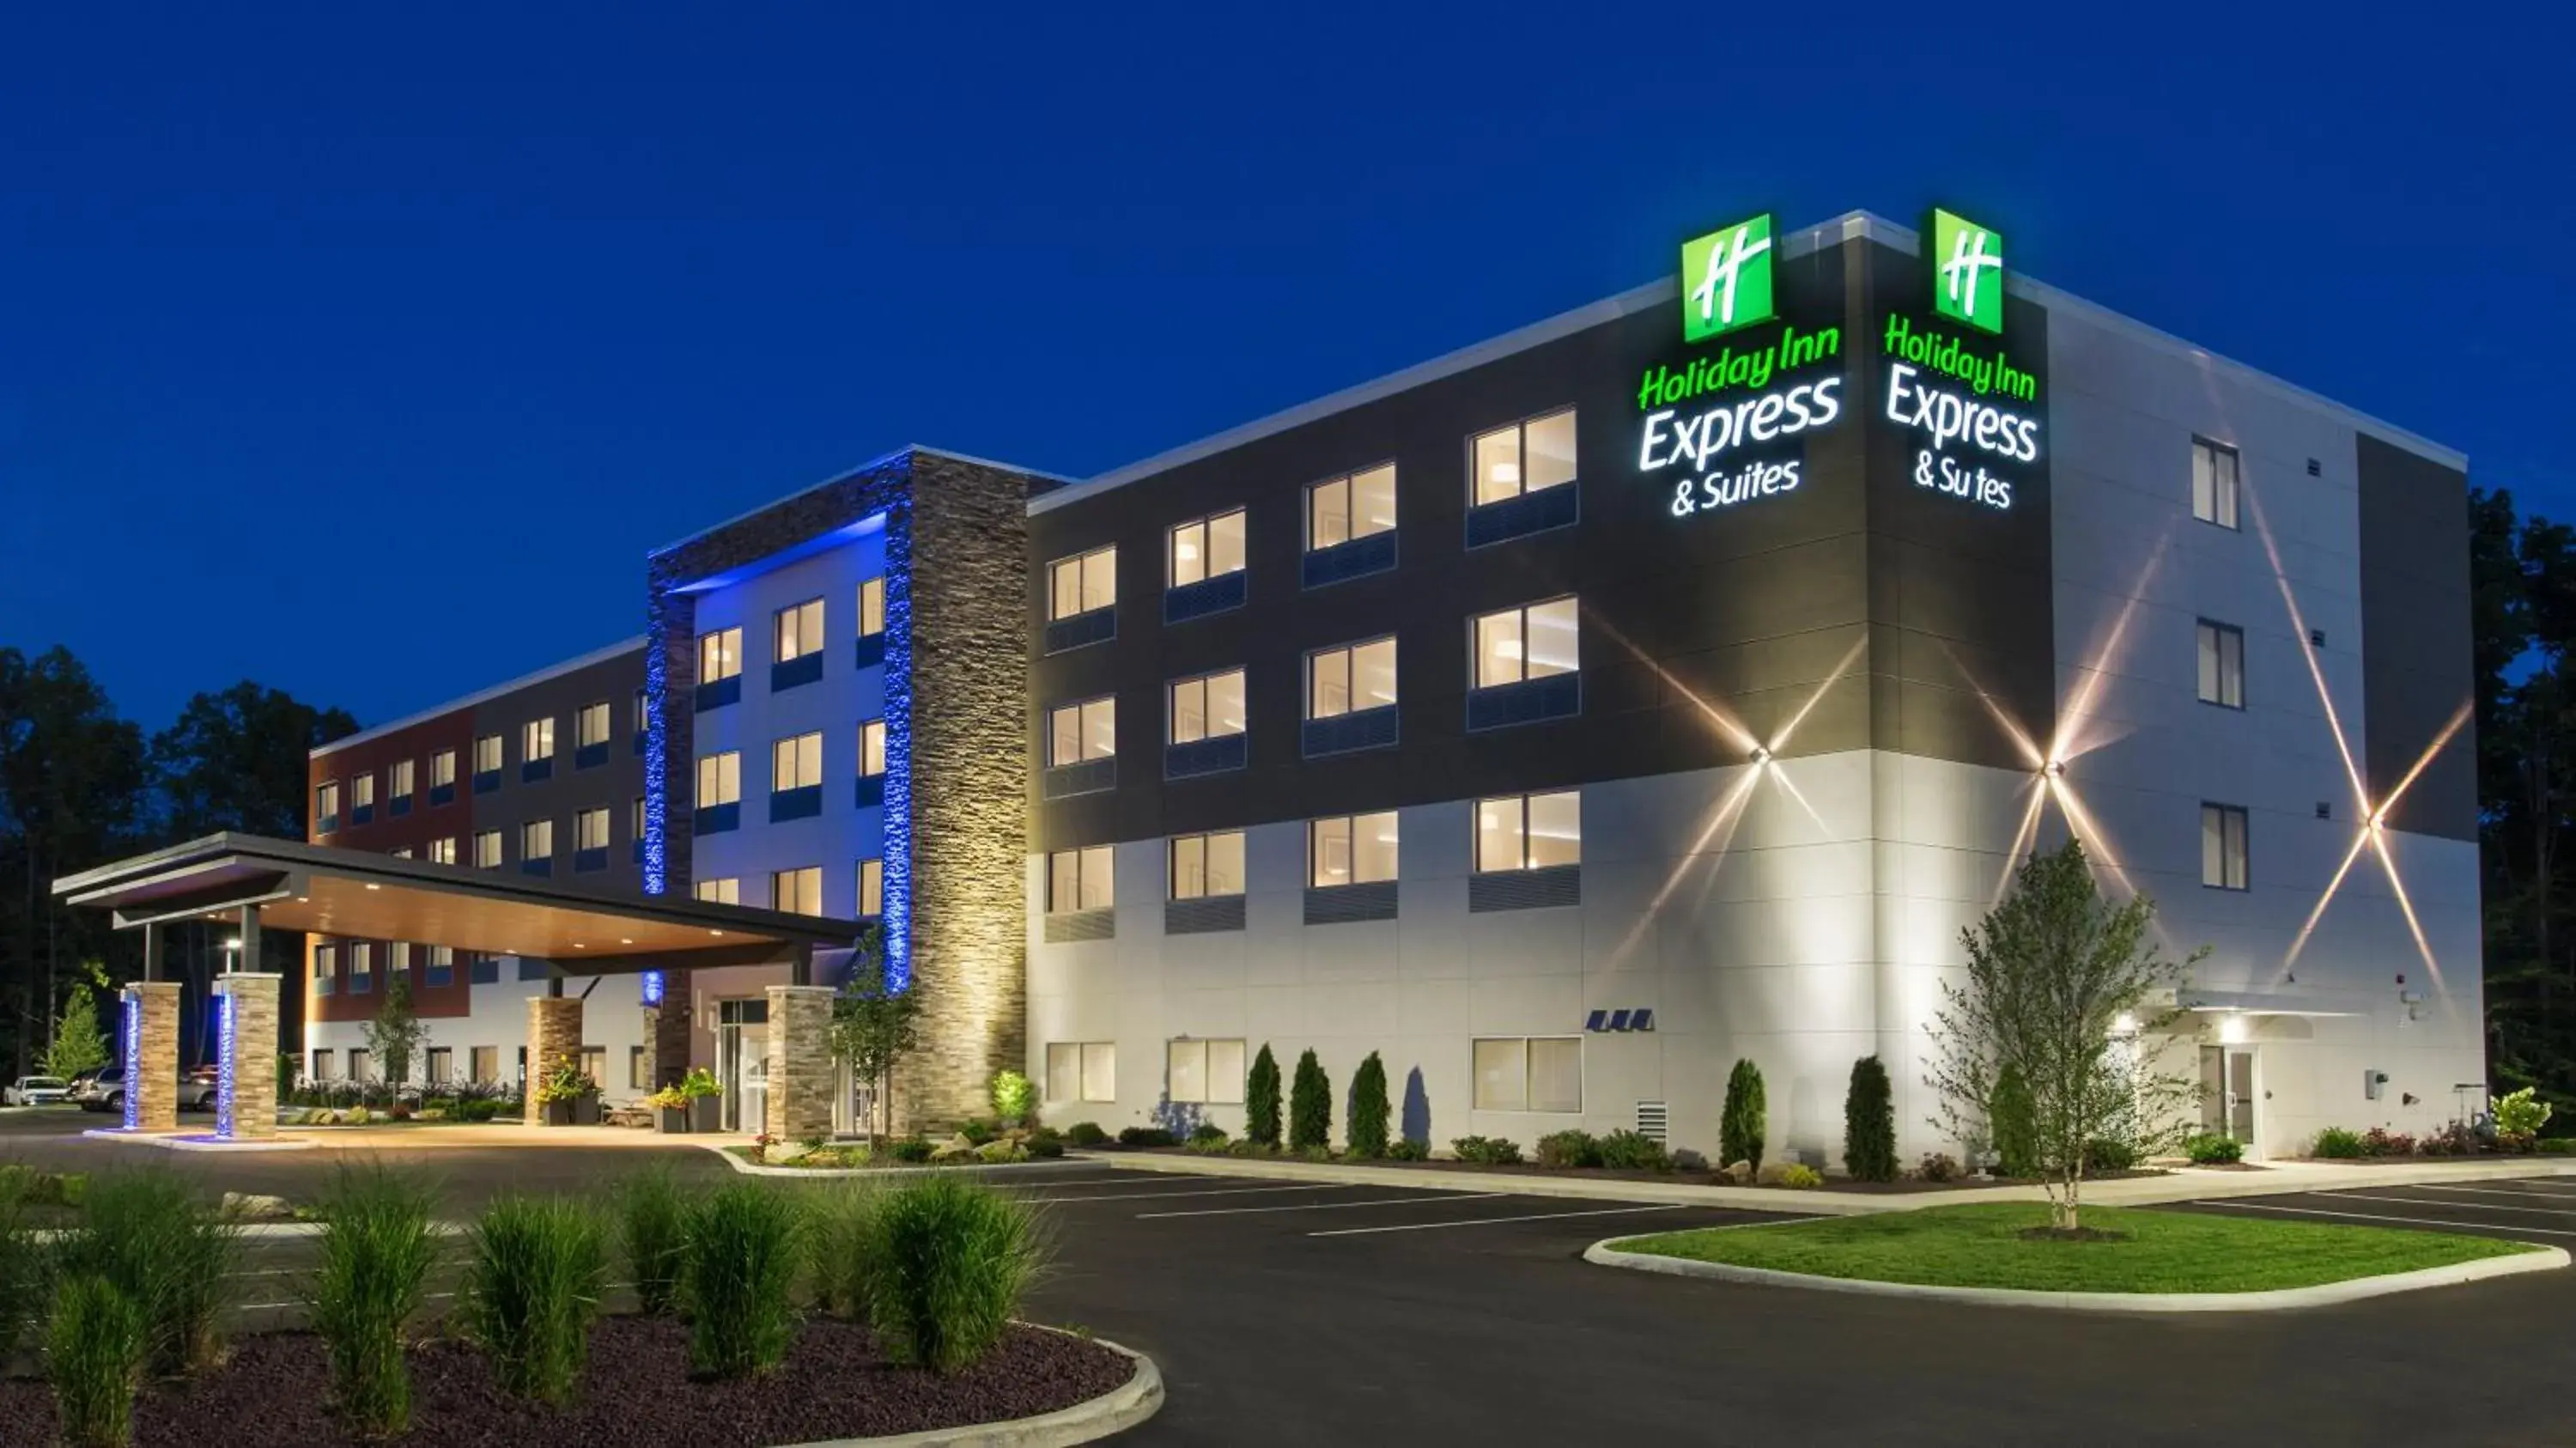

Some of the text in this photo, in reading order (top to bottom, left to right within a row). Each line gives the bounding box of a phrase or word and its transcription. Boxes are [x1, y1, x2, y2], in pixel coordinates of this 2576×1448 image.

[1637, 326, 1839, 410] Holiday Inn
[1884, 313, 2036, 401] Holiday Inn
[1639, 377, 1841, 472] Express
[1886, 362, 2038, 462] Express
[1671, 461, 1801, 516] & Suites
[1915, 449, 2011, 508] & Sutes
